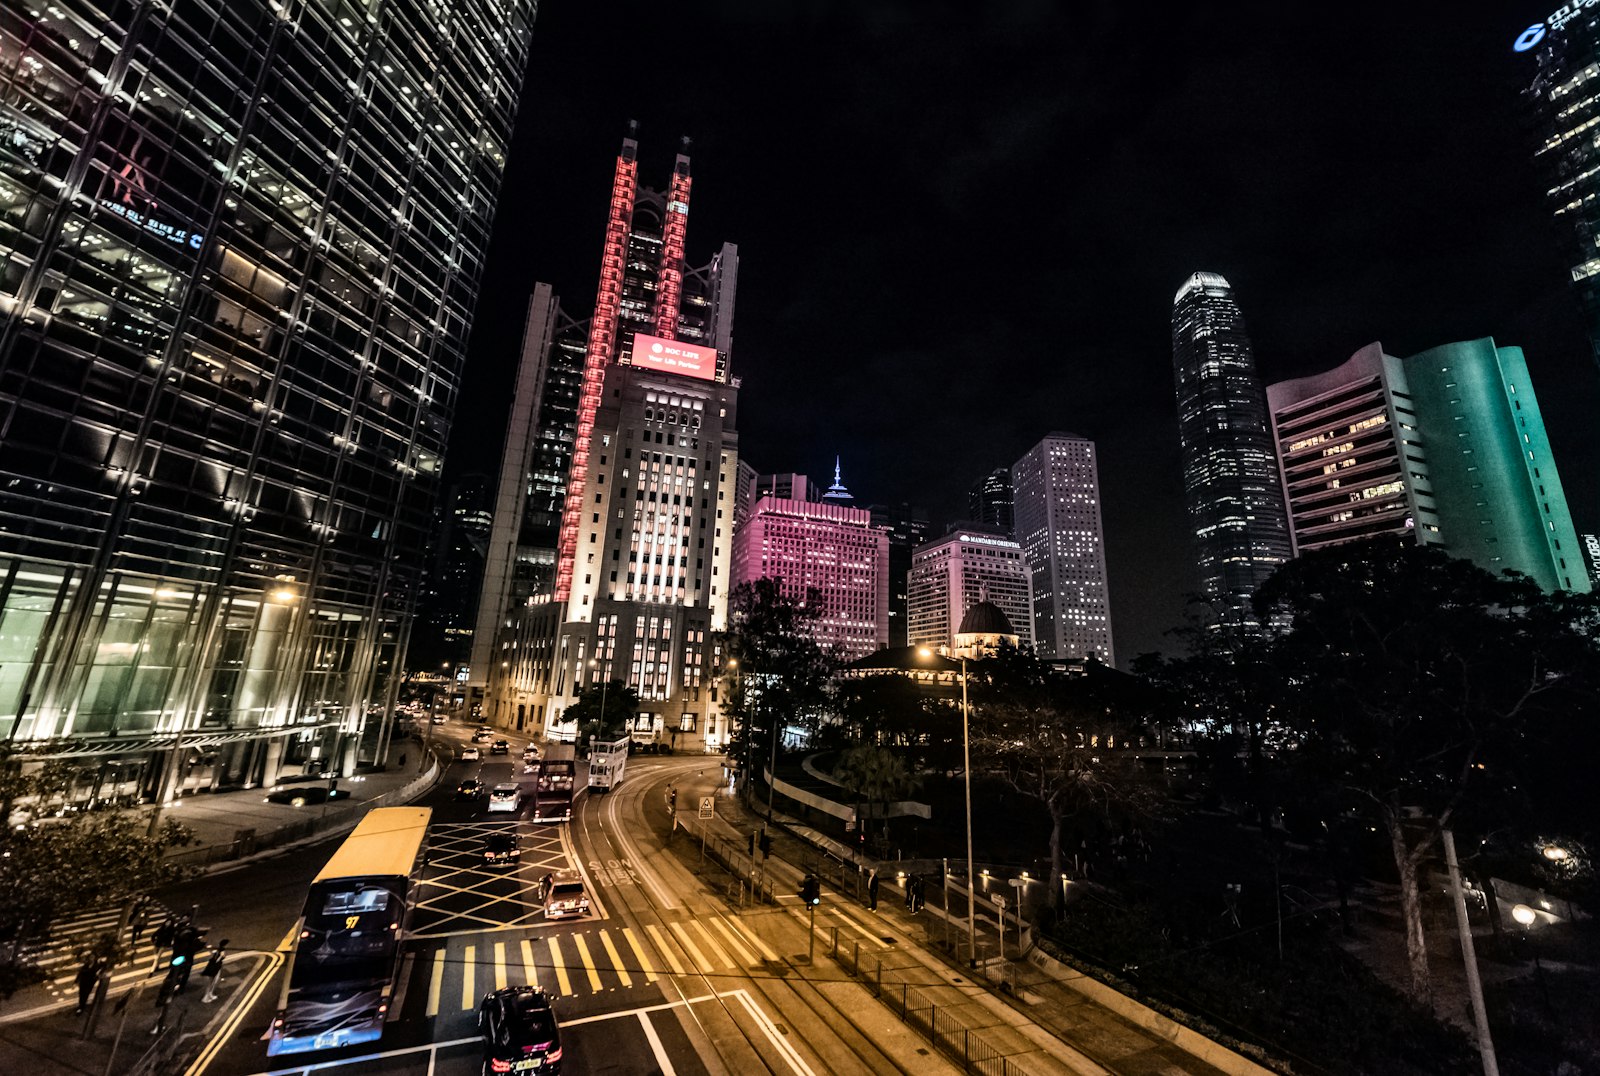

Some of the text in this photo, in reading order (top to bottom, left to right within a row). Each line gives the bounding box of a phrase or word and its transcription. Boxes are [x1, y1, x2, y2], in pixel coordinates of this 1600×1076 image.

[665, 347, 700, 360] BOC LIFE
[648, 354, 701, 370] Your Life Partner
[970, 536, 1021, 549] MANDARIN ORIENTAL
[345, 915, 361, 930] 97
